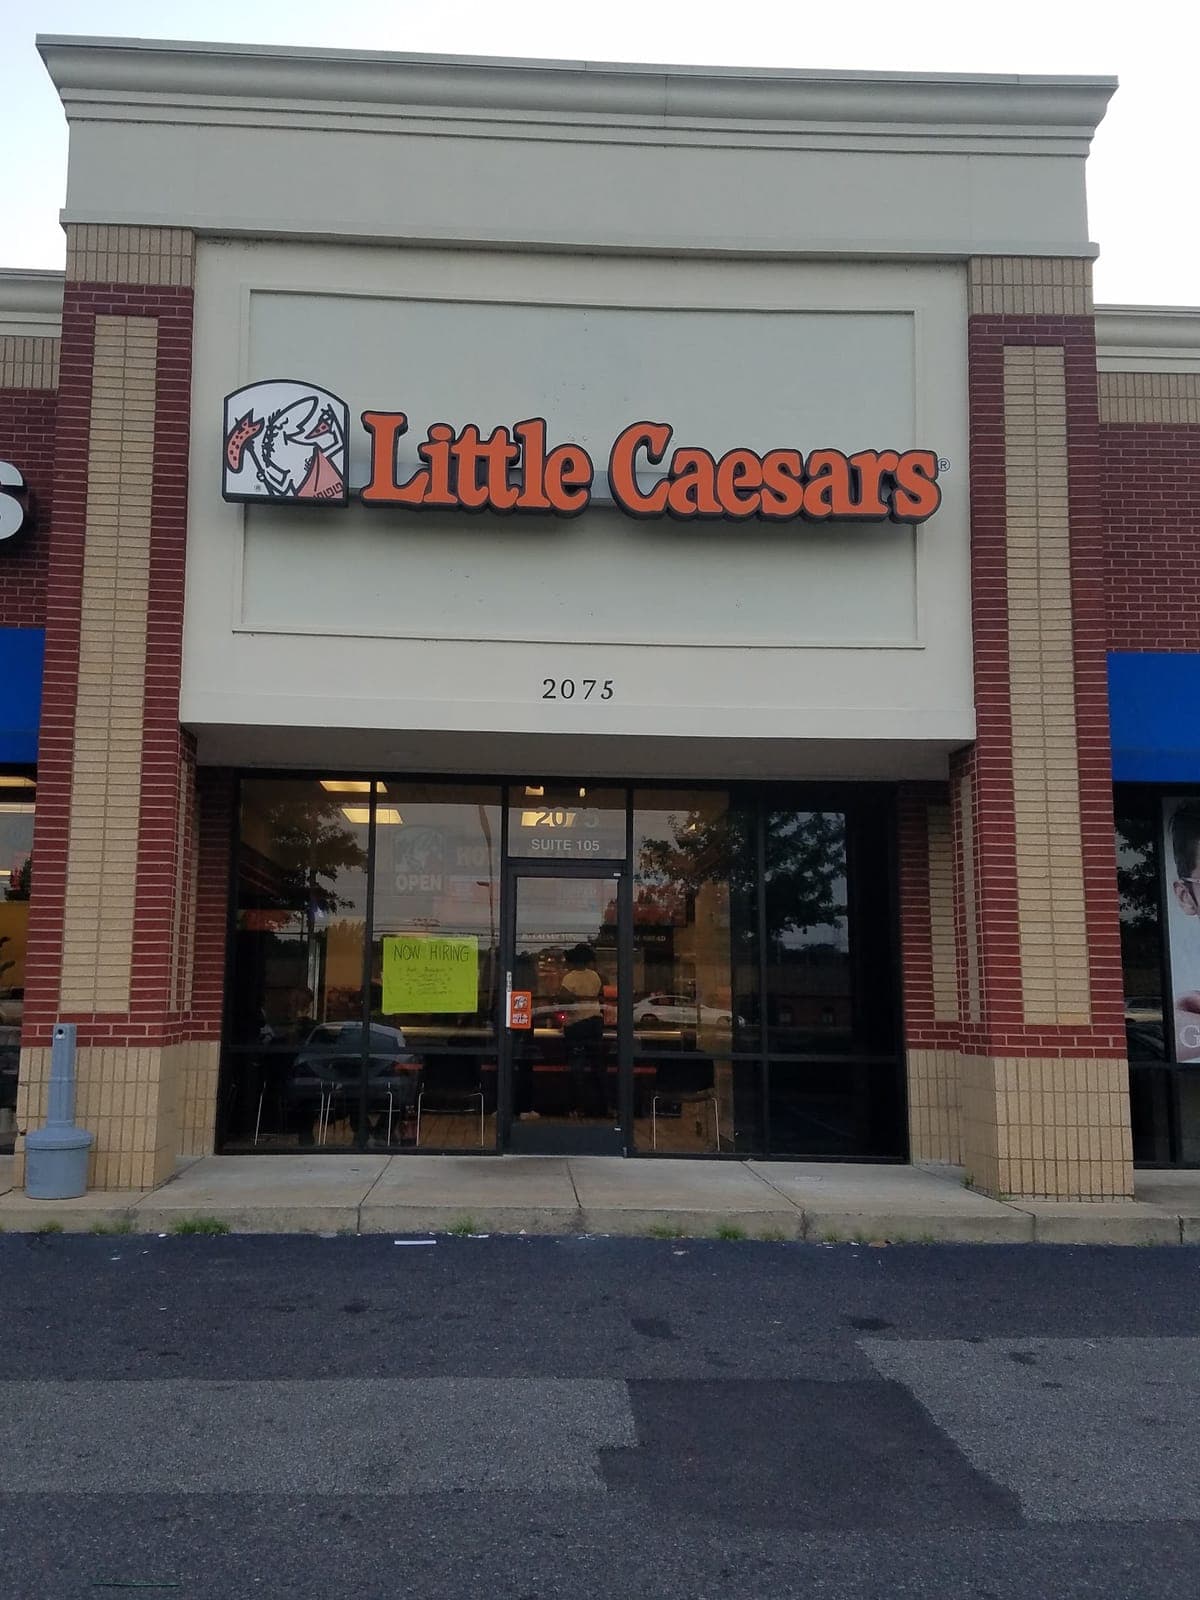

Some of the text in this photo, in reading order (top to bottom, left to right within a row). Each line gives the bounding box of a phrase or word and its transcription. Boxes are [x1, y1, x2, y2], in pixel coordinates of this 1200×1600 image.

[361, 411, 942, 522] Little Caesars
[542, 678, 613, 700] 2075
[531, 839, 600, 852] SUITE 105
[395, 874, 442, 891] OPEN
[393, 943, 469, 962] NOW HIRING
